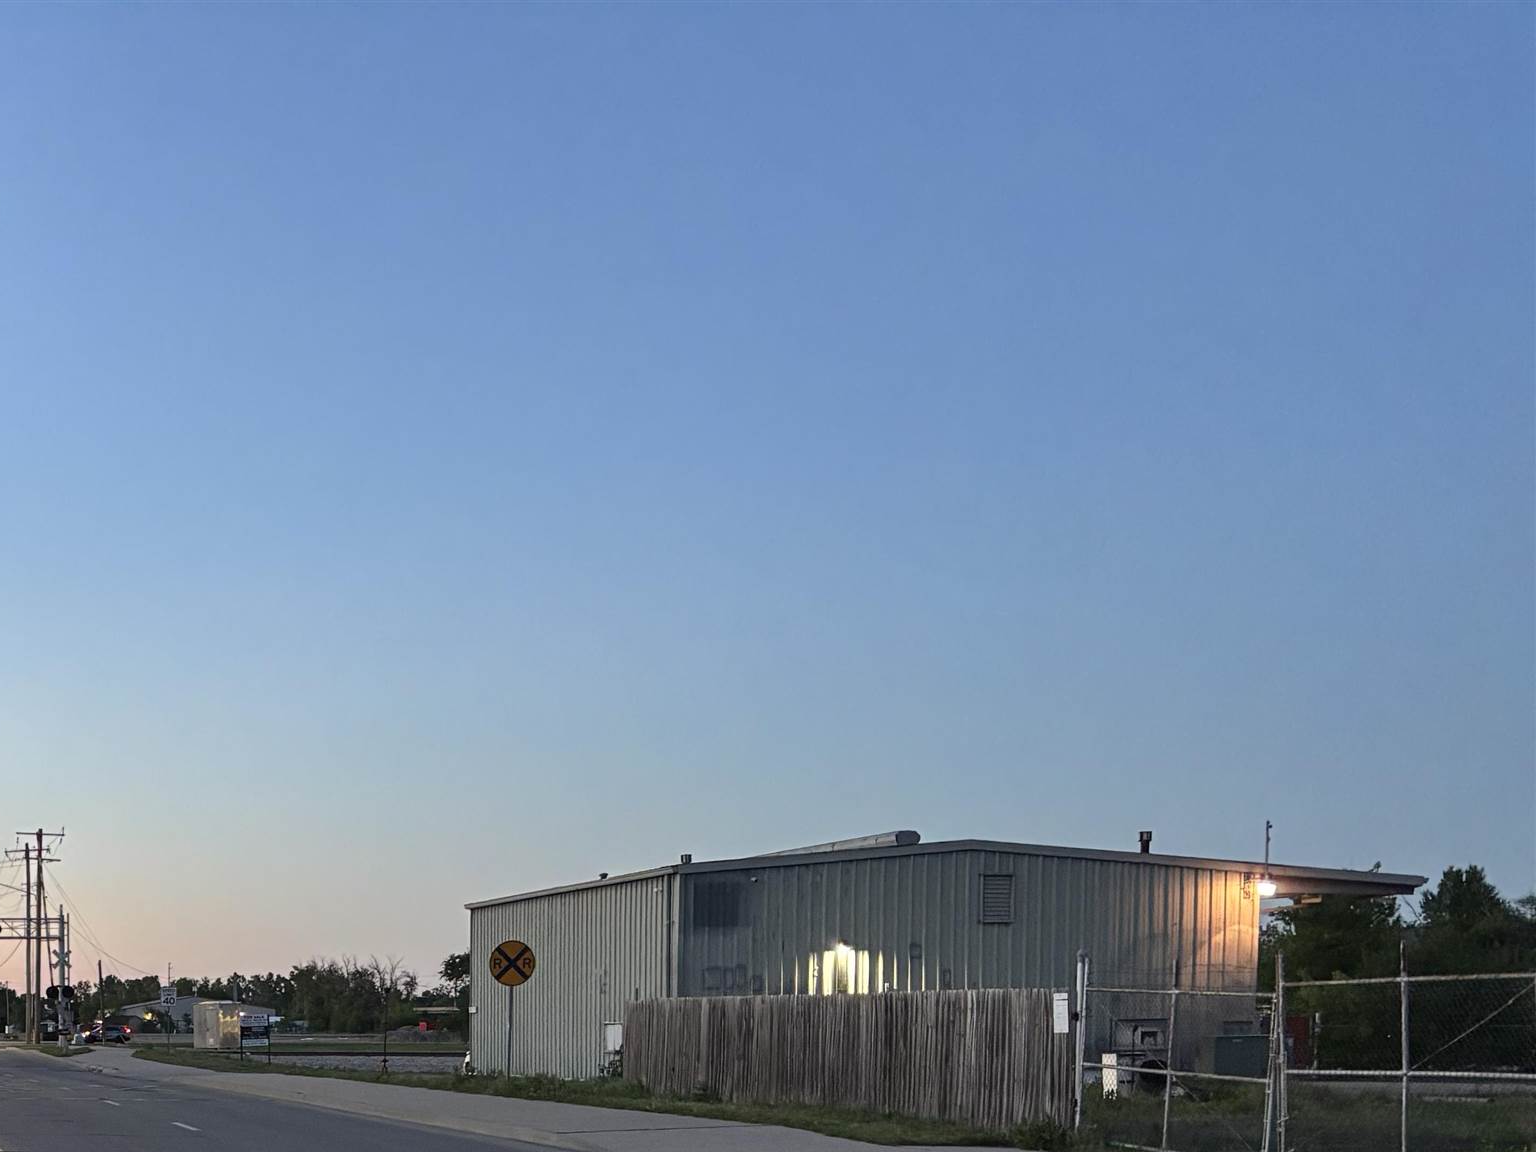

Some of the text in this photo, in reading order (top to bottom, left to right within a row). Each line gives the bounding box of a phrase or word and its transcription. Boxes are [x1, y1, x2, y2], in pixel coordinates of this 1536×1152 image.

[493, 958, 531, 969] R R
[162, 996, 175, 1005] 40
